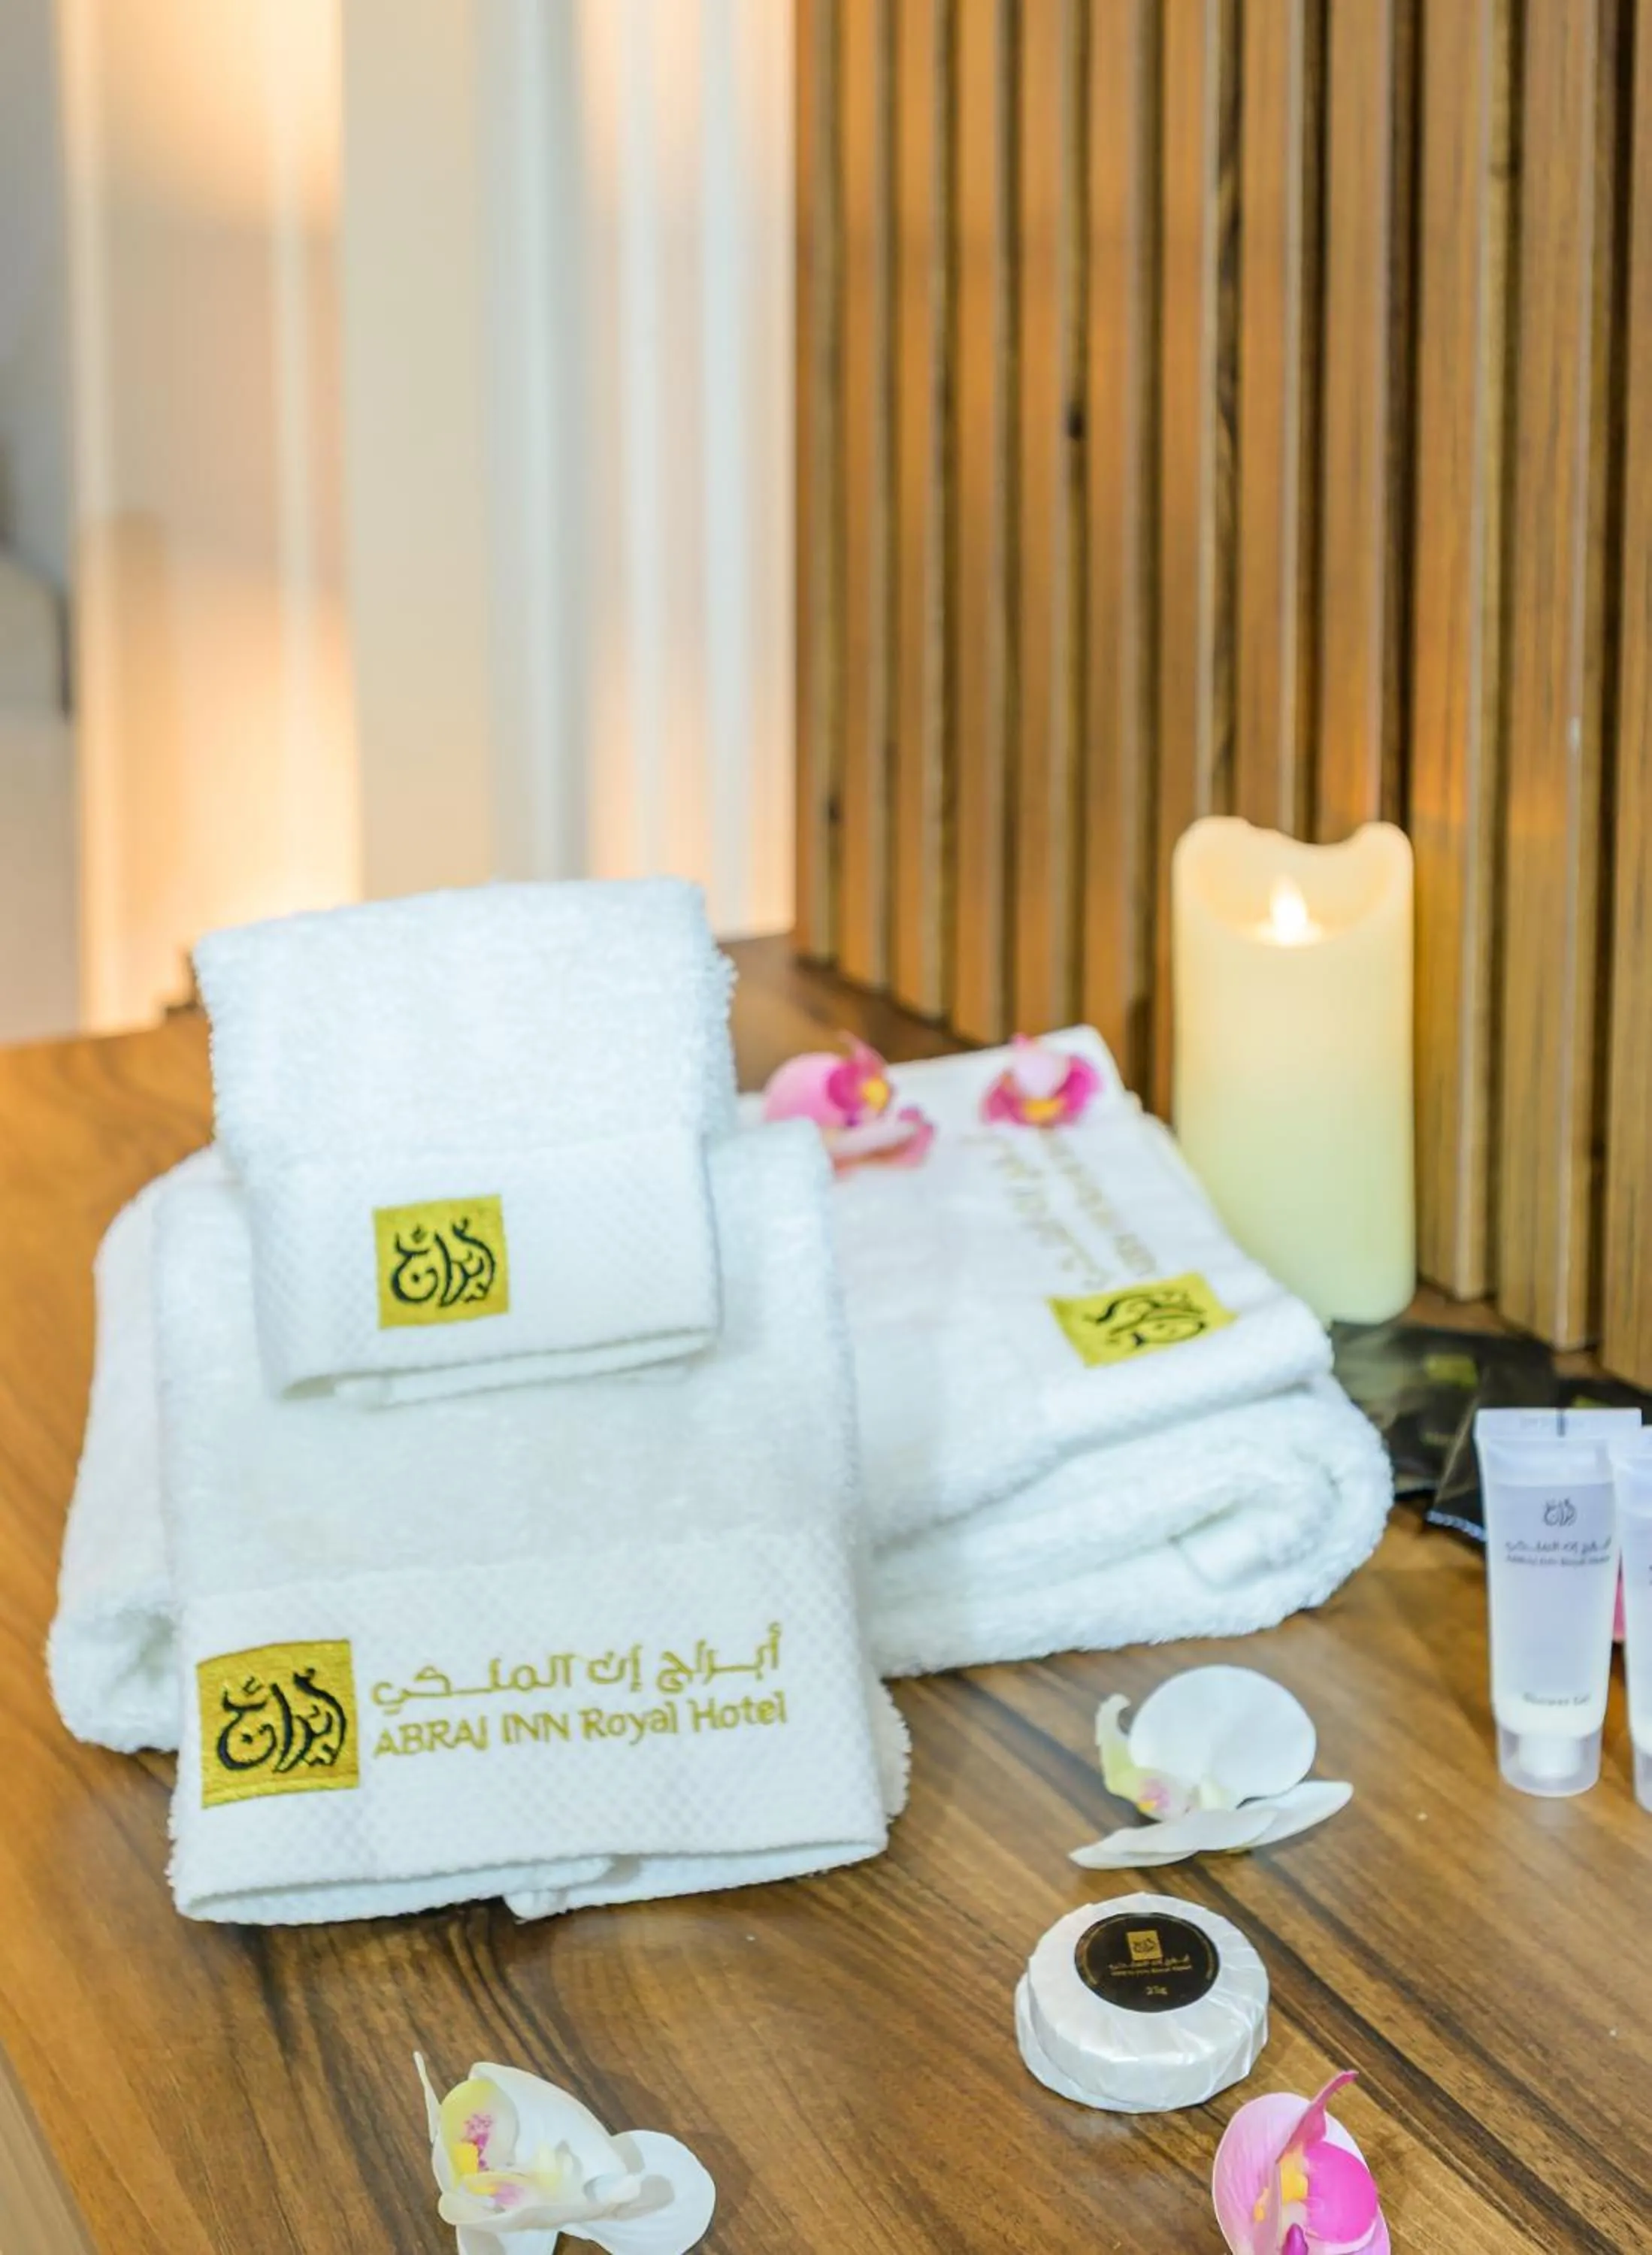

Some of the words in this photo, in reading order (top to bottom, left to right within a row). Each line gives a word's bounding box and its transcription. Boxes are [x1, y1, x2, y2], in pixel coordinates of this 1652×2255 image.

[374, 1715, 489, 1759] ABRAJ
[503, 1712, 570, 1744] INN
[579, 1700, 679, 1746] Royal
[686, 1690, 787, 1733] Hotel
